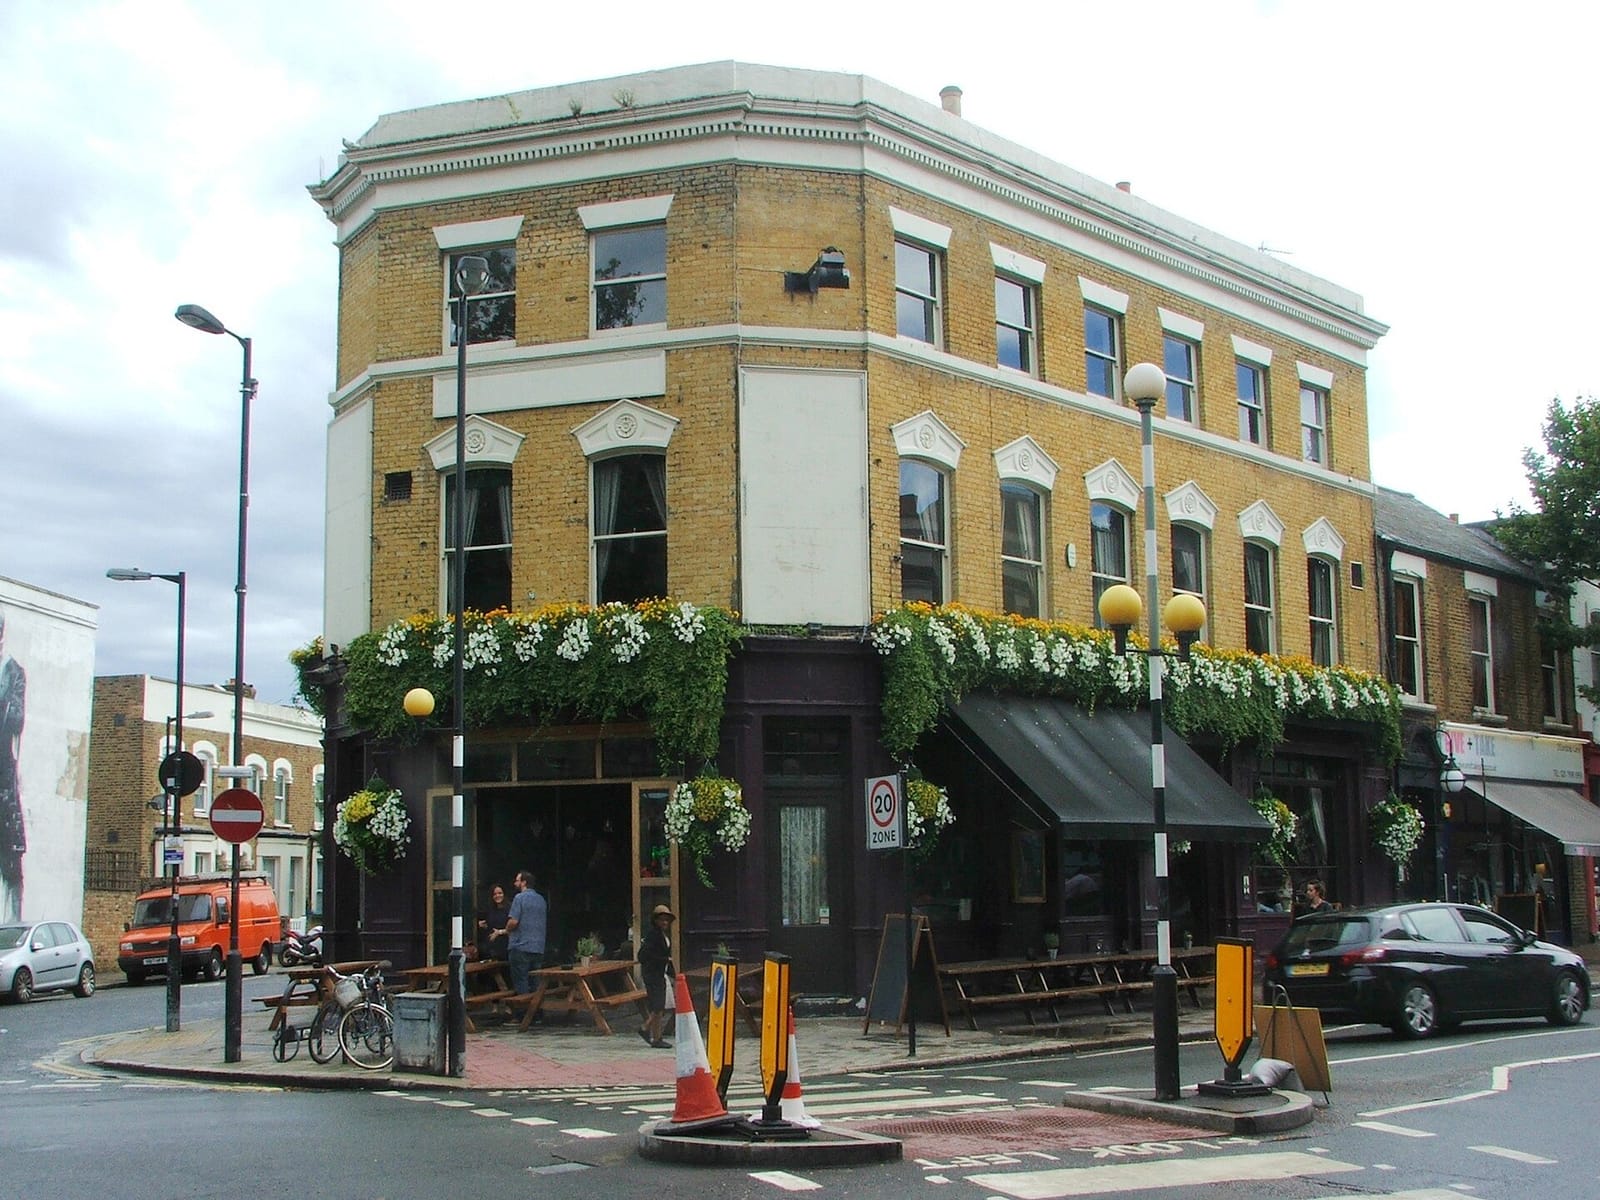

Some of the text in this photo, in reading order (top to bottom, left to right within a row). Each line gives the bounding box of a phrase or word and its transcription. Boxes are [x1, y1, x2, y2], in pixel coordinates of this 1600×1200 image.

[874, 794, 892, 814] 20
[872, 830, 896, 843] ZONE
[913, 1140, 1222, 1171] LOOK LEFT
